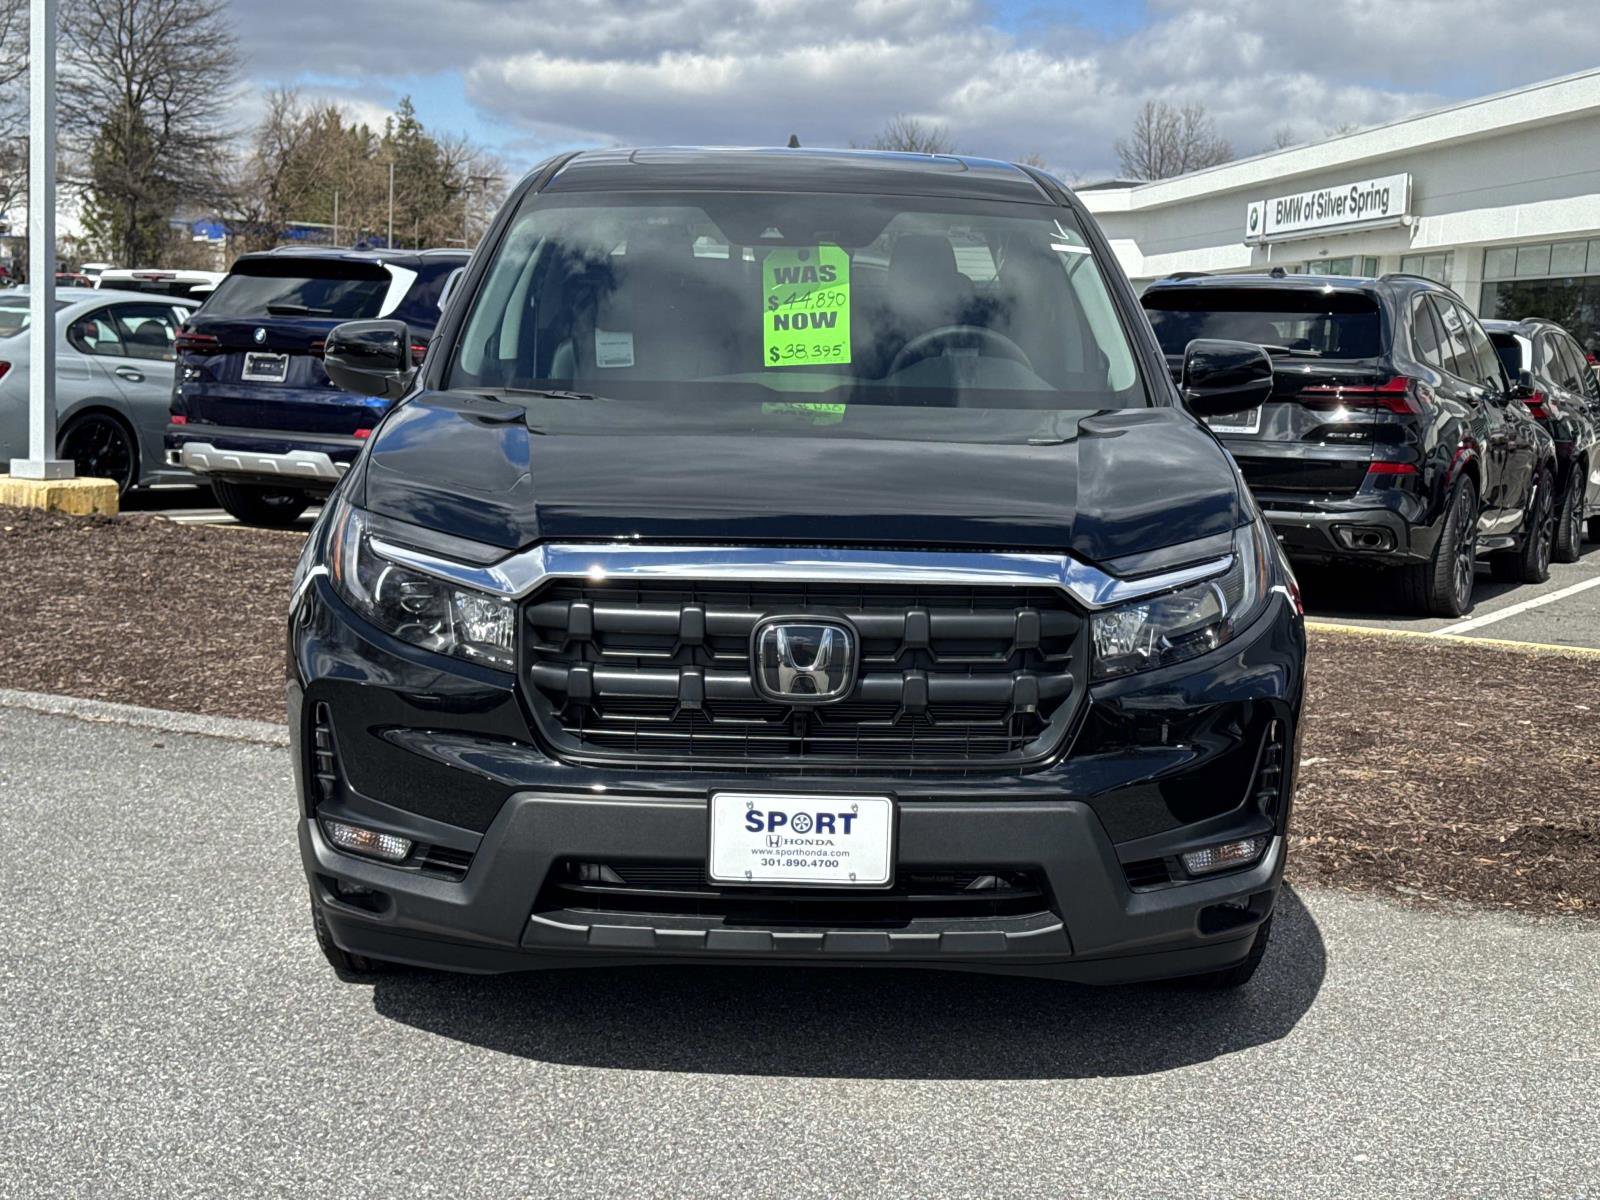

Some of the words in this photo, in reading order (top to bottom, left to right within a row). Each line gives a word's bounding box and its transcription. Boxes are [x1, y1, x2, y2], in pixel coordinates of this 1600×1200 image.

[1276, 196, 1304, 225] BMW
[1304, 195, 1317, 221] of
[1316, 191, 1348, 220] Silver
[1349, 182, 1390, 218] Spring
[773, 264, 837, 285] WAS
[773, 311, 838, 331] NOW
[745, 809, 858, 835] SPORT
[751, 847, 850, 858] www.sporthonda.com
[784, 838, 835, 847] HONDA
[761, 857, 839, 868] 301.890.4700
